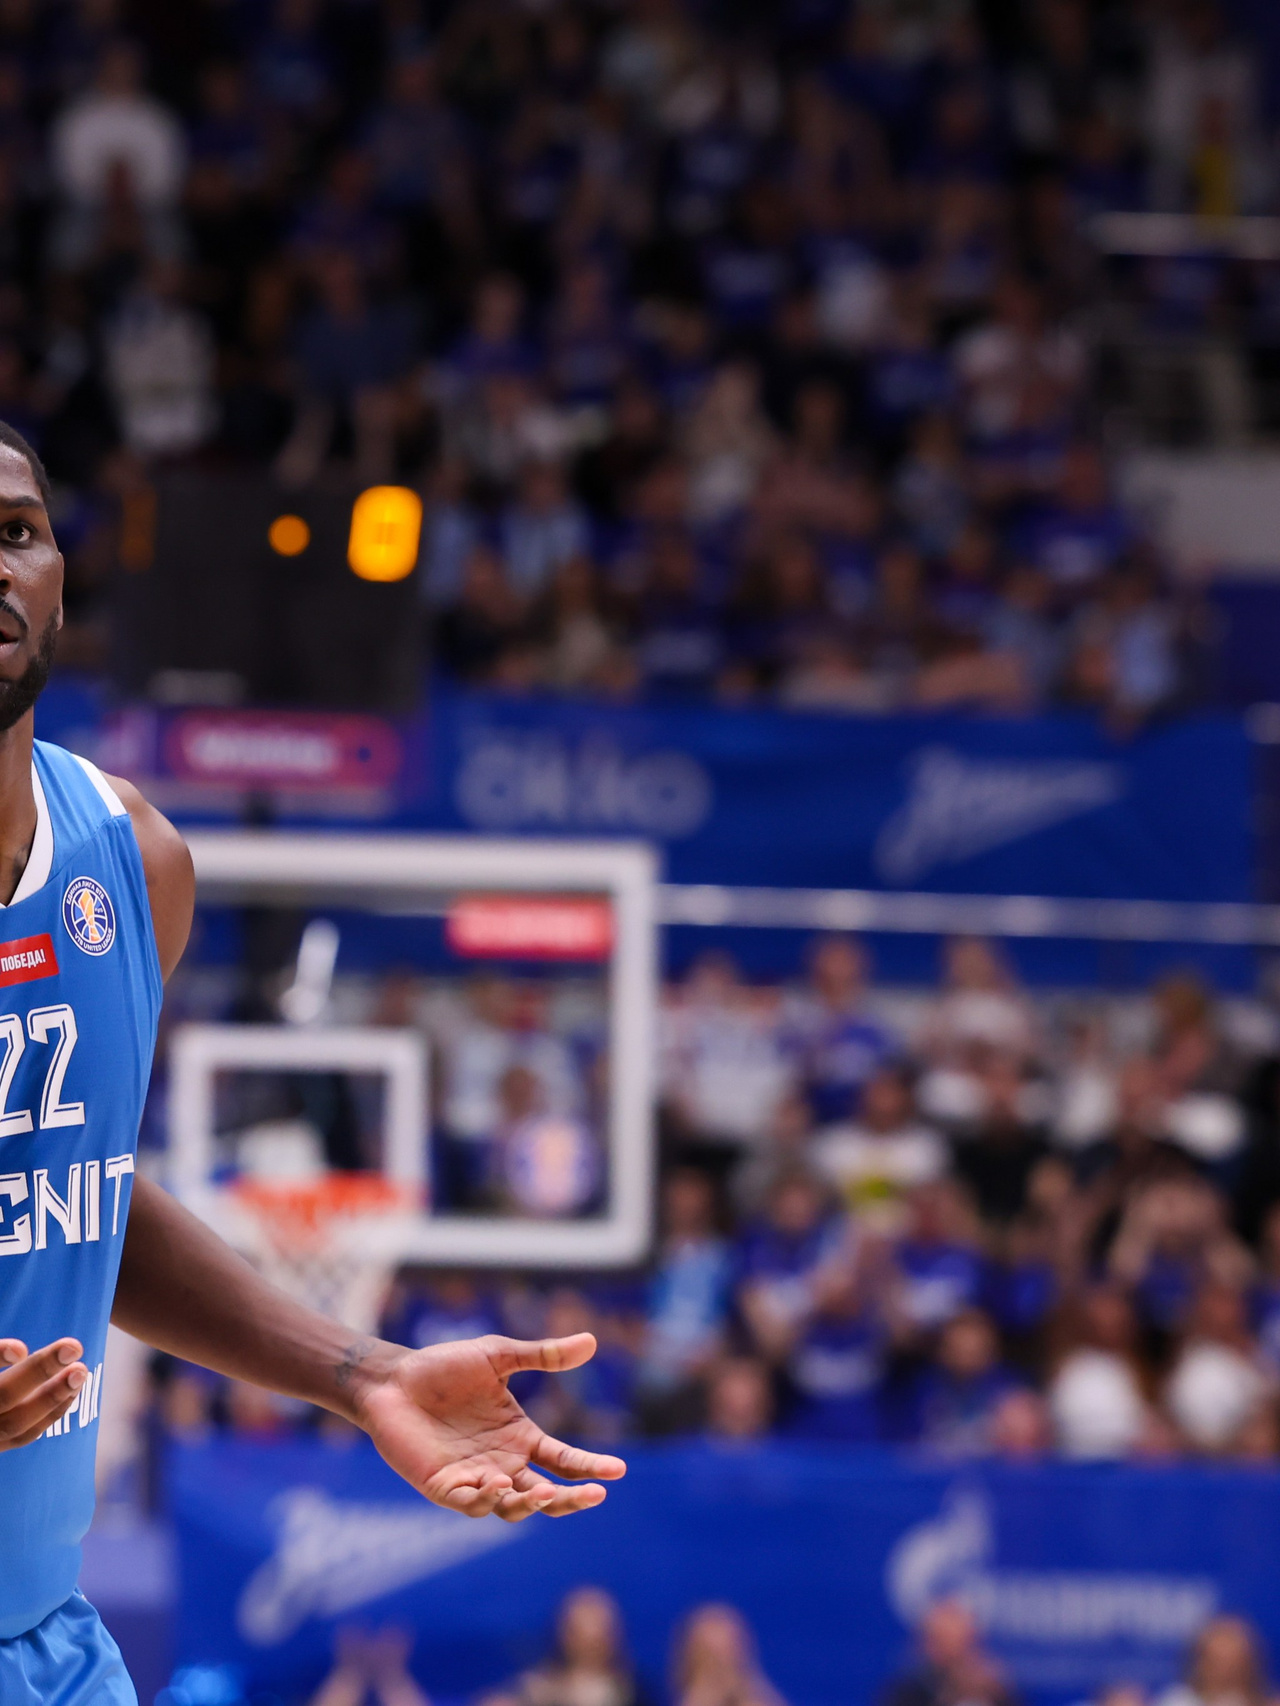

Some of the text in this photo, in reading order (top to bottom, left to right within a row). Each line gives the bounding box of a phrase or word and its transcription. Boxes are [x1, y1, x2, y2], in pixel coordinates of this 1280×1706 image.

[66, 881, 82, 905] ЕДИНАЯ
[83, 941, 102, 953] UNITED
[101, 927, 113, 950] LEAGUE
[0, 948, 46, 972] ПОБЕДА!
